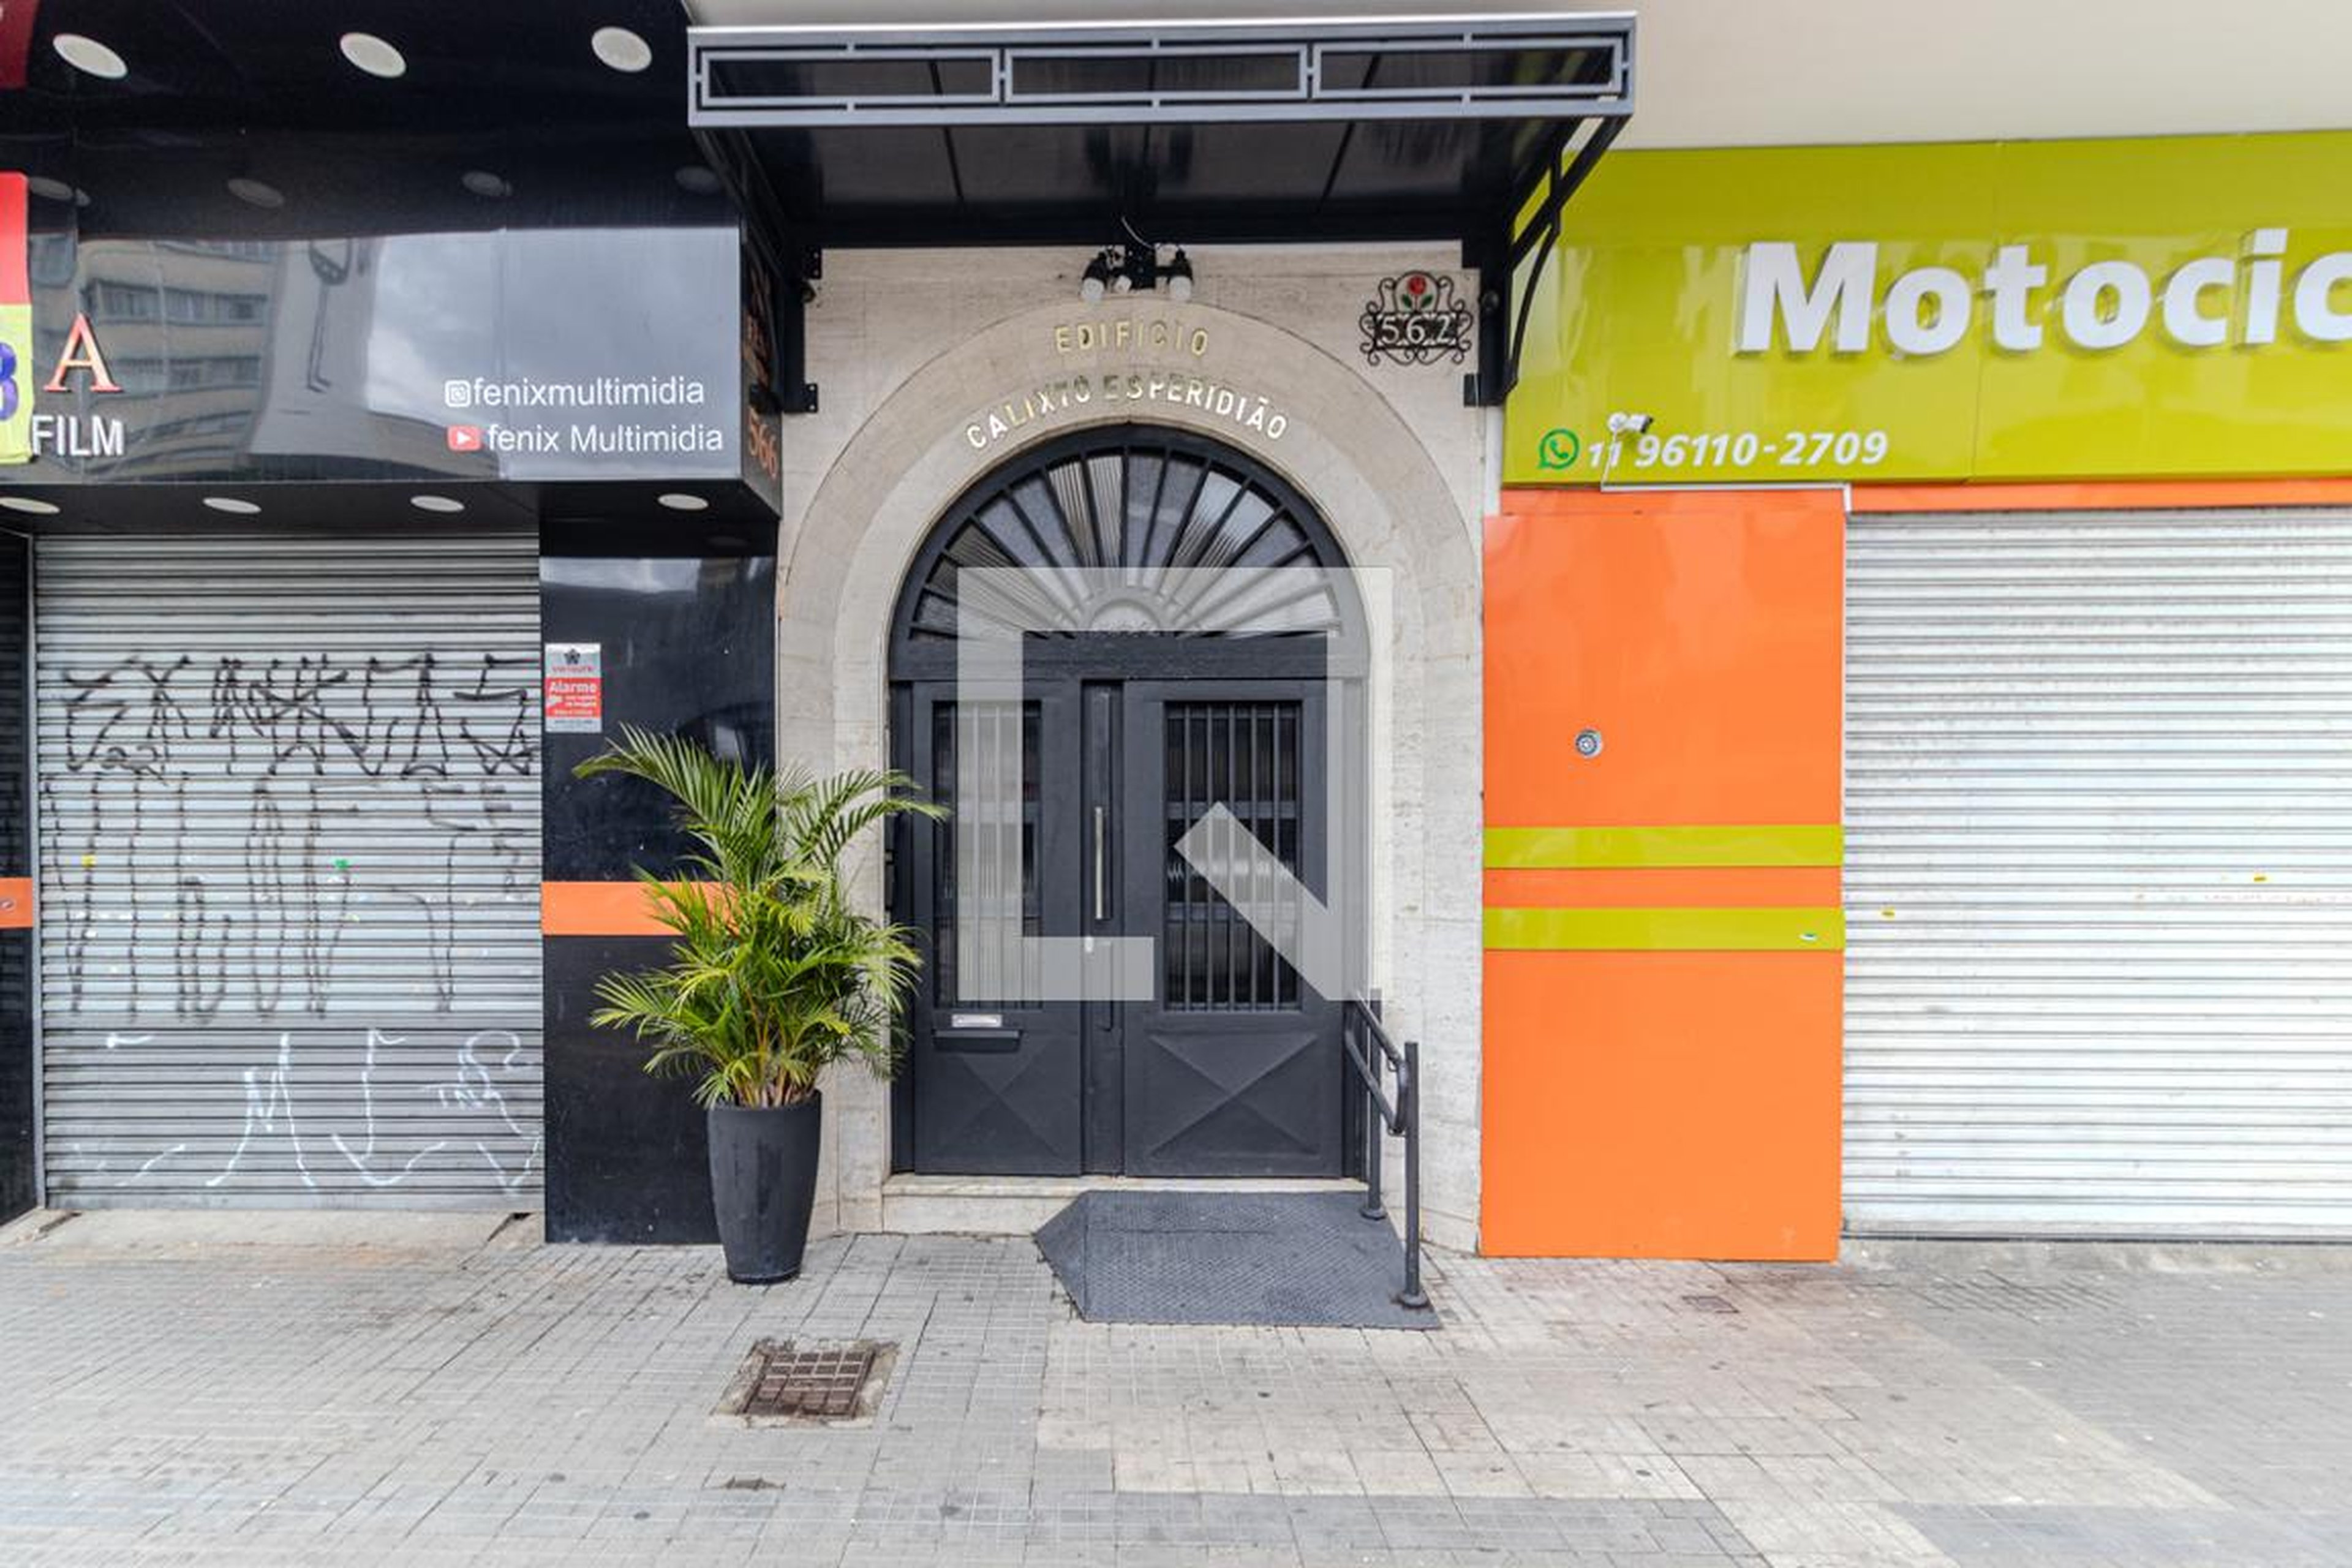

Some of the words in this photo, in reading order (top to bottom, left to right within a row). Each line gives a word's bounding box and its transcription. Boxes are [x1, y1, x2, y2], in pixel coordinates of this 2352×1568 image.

[1054, 320, 1209, 358] EDIFICIO
[1381, 314, 1450, 344] 562
[473, 376, 705, 407] fenixmultimidia
[967, 374, 1090, 449] CALIXTO
[1102, 372, 1287, 440] ESPERIDIÃO
[32, 415, 123, 457] FILM
[489, 423, 560, 452] fenix
[570, 423, 724, 453] Multimidia
[1634, 430, 1888, 468] 96110-2709
